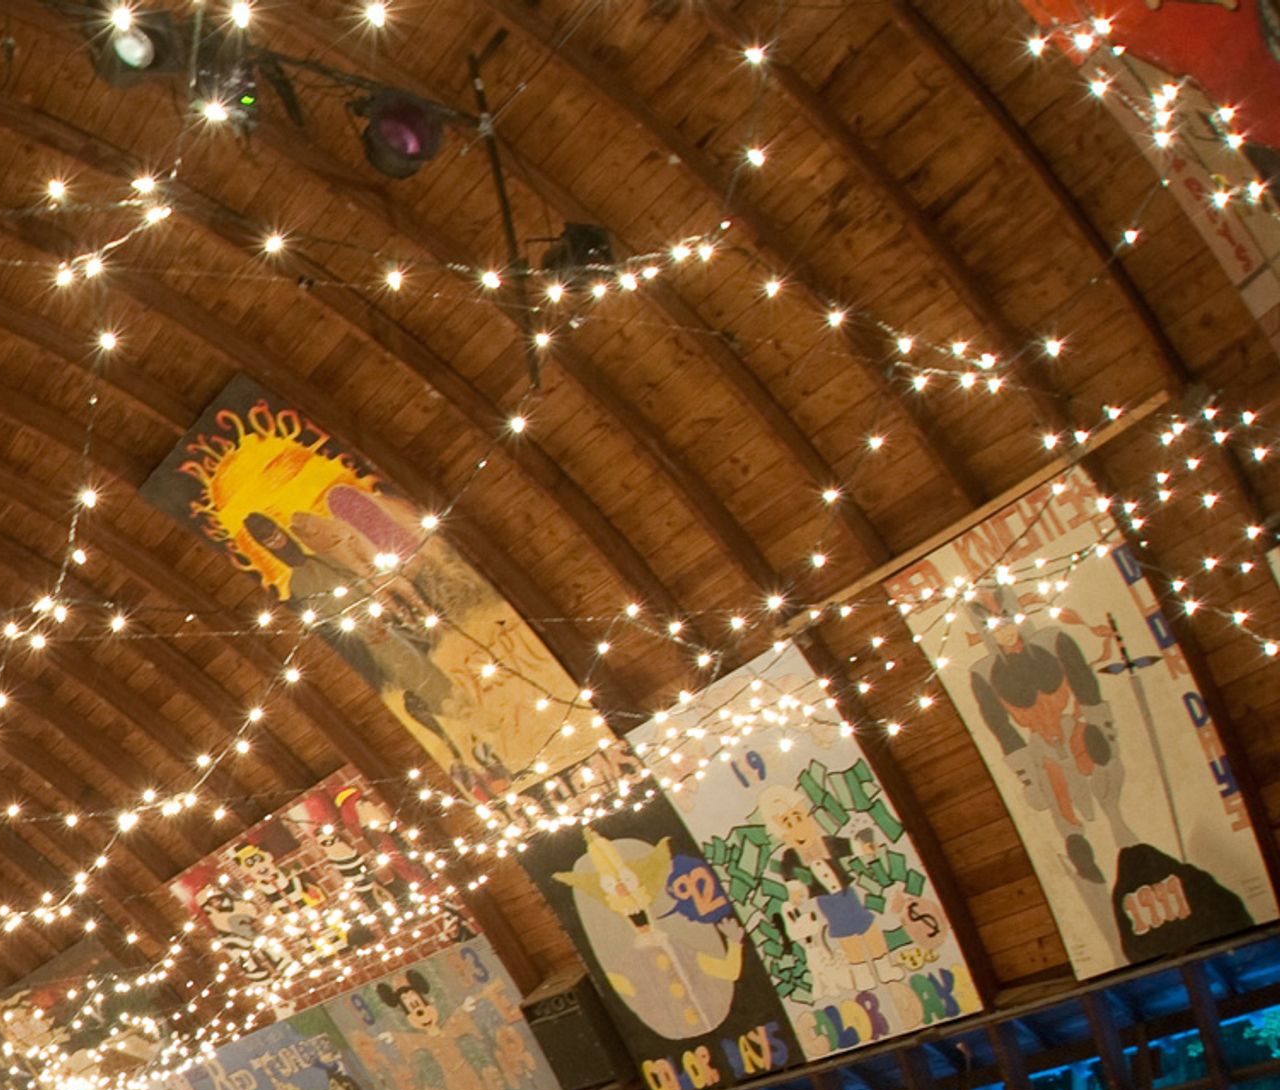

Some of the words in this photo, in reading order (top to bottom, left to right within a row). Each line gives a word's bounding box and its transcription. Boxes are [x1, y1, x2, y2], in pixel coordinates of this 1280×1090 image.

[672, 866, 728, 917] 92
[796, 991, 890, 1057] COLOR
[890, 963, 982, 1030] DAYS
